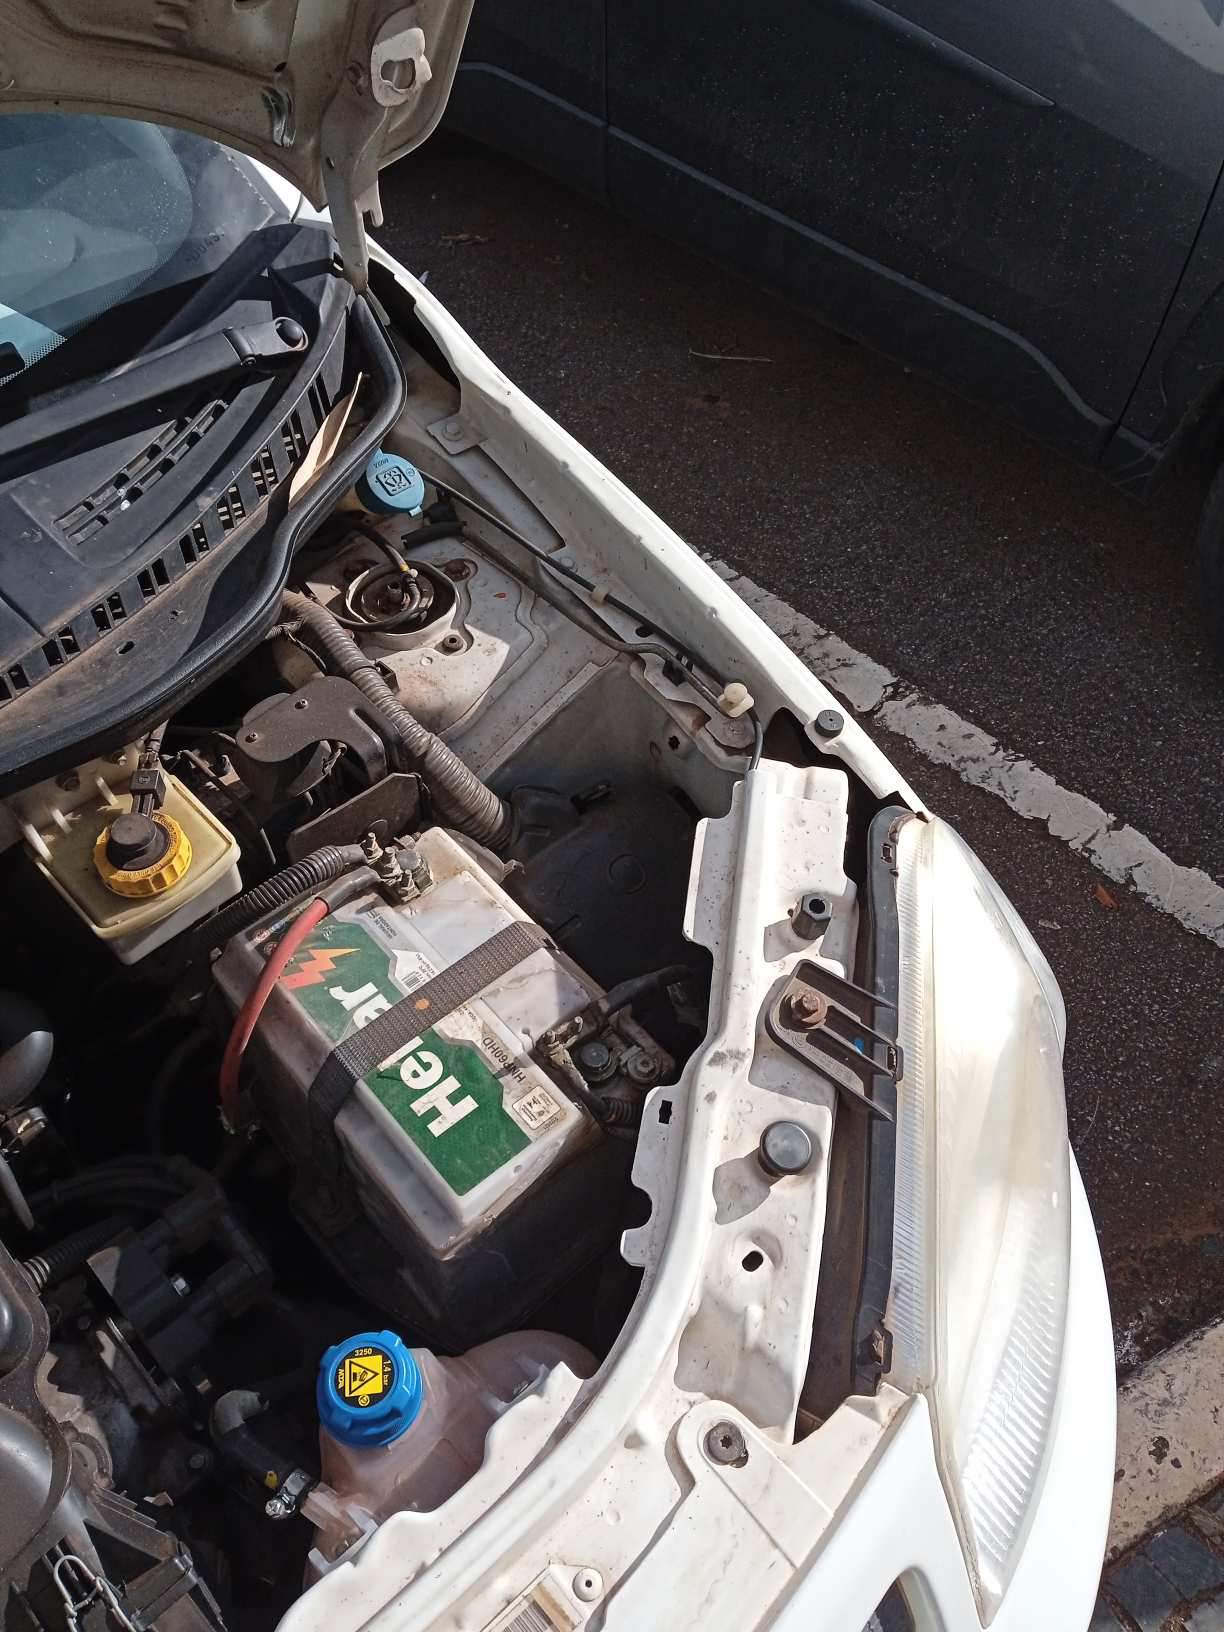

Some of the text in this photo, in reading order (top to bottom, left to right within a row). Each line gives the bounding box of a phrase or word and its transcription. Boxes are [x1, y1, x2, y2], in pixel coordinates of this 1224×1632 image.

[328, 982, 479, 1138] Helar
[482, 1037, 527, 1084] HNP60HD
[354, 1348, 372, 1356] 3250
[383, 1360, 392, 1372] 1.4
